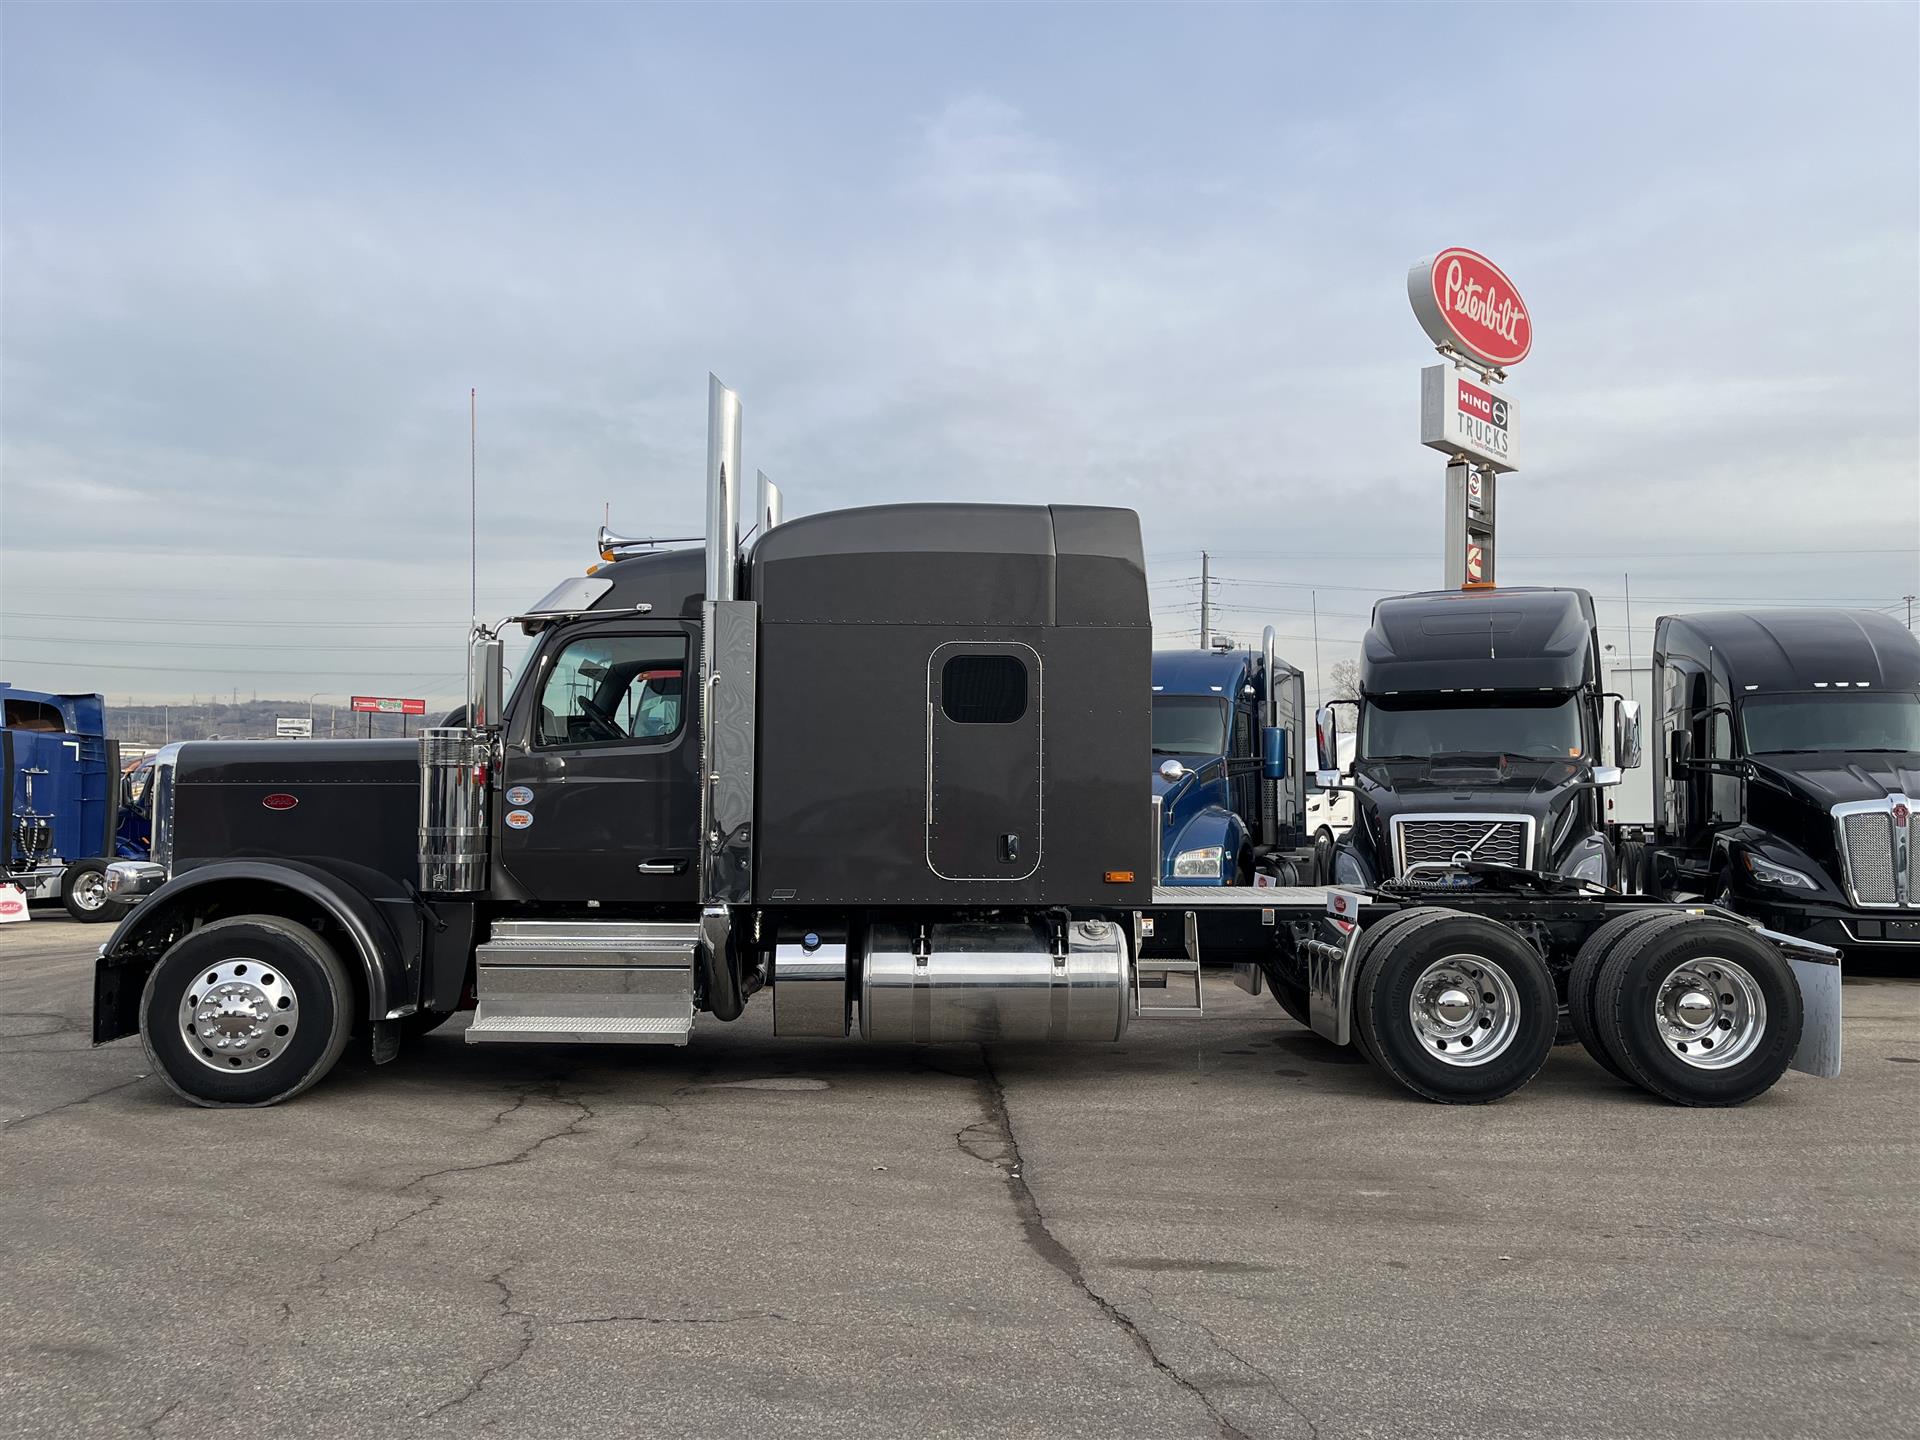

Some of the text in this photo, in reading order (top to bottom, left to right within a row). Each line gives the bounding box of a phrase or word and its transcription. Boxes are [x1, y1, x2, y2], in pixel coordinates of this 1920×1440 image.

[1445, 259, 1524, 344] Peterbilt
[1460, 390, 1490, 414] HINO
[1457, 412, 1508, 453] TRUCKS
[1647, 937, 1698, 981] Continental
